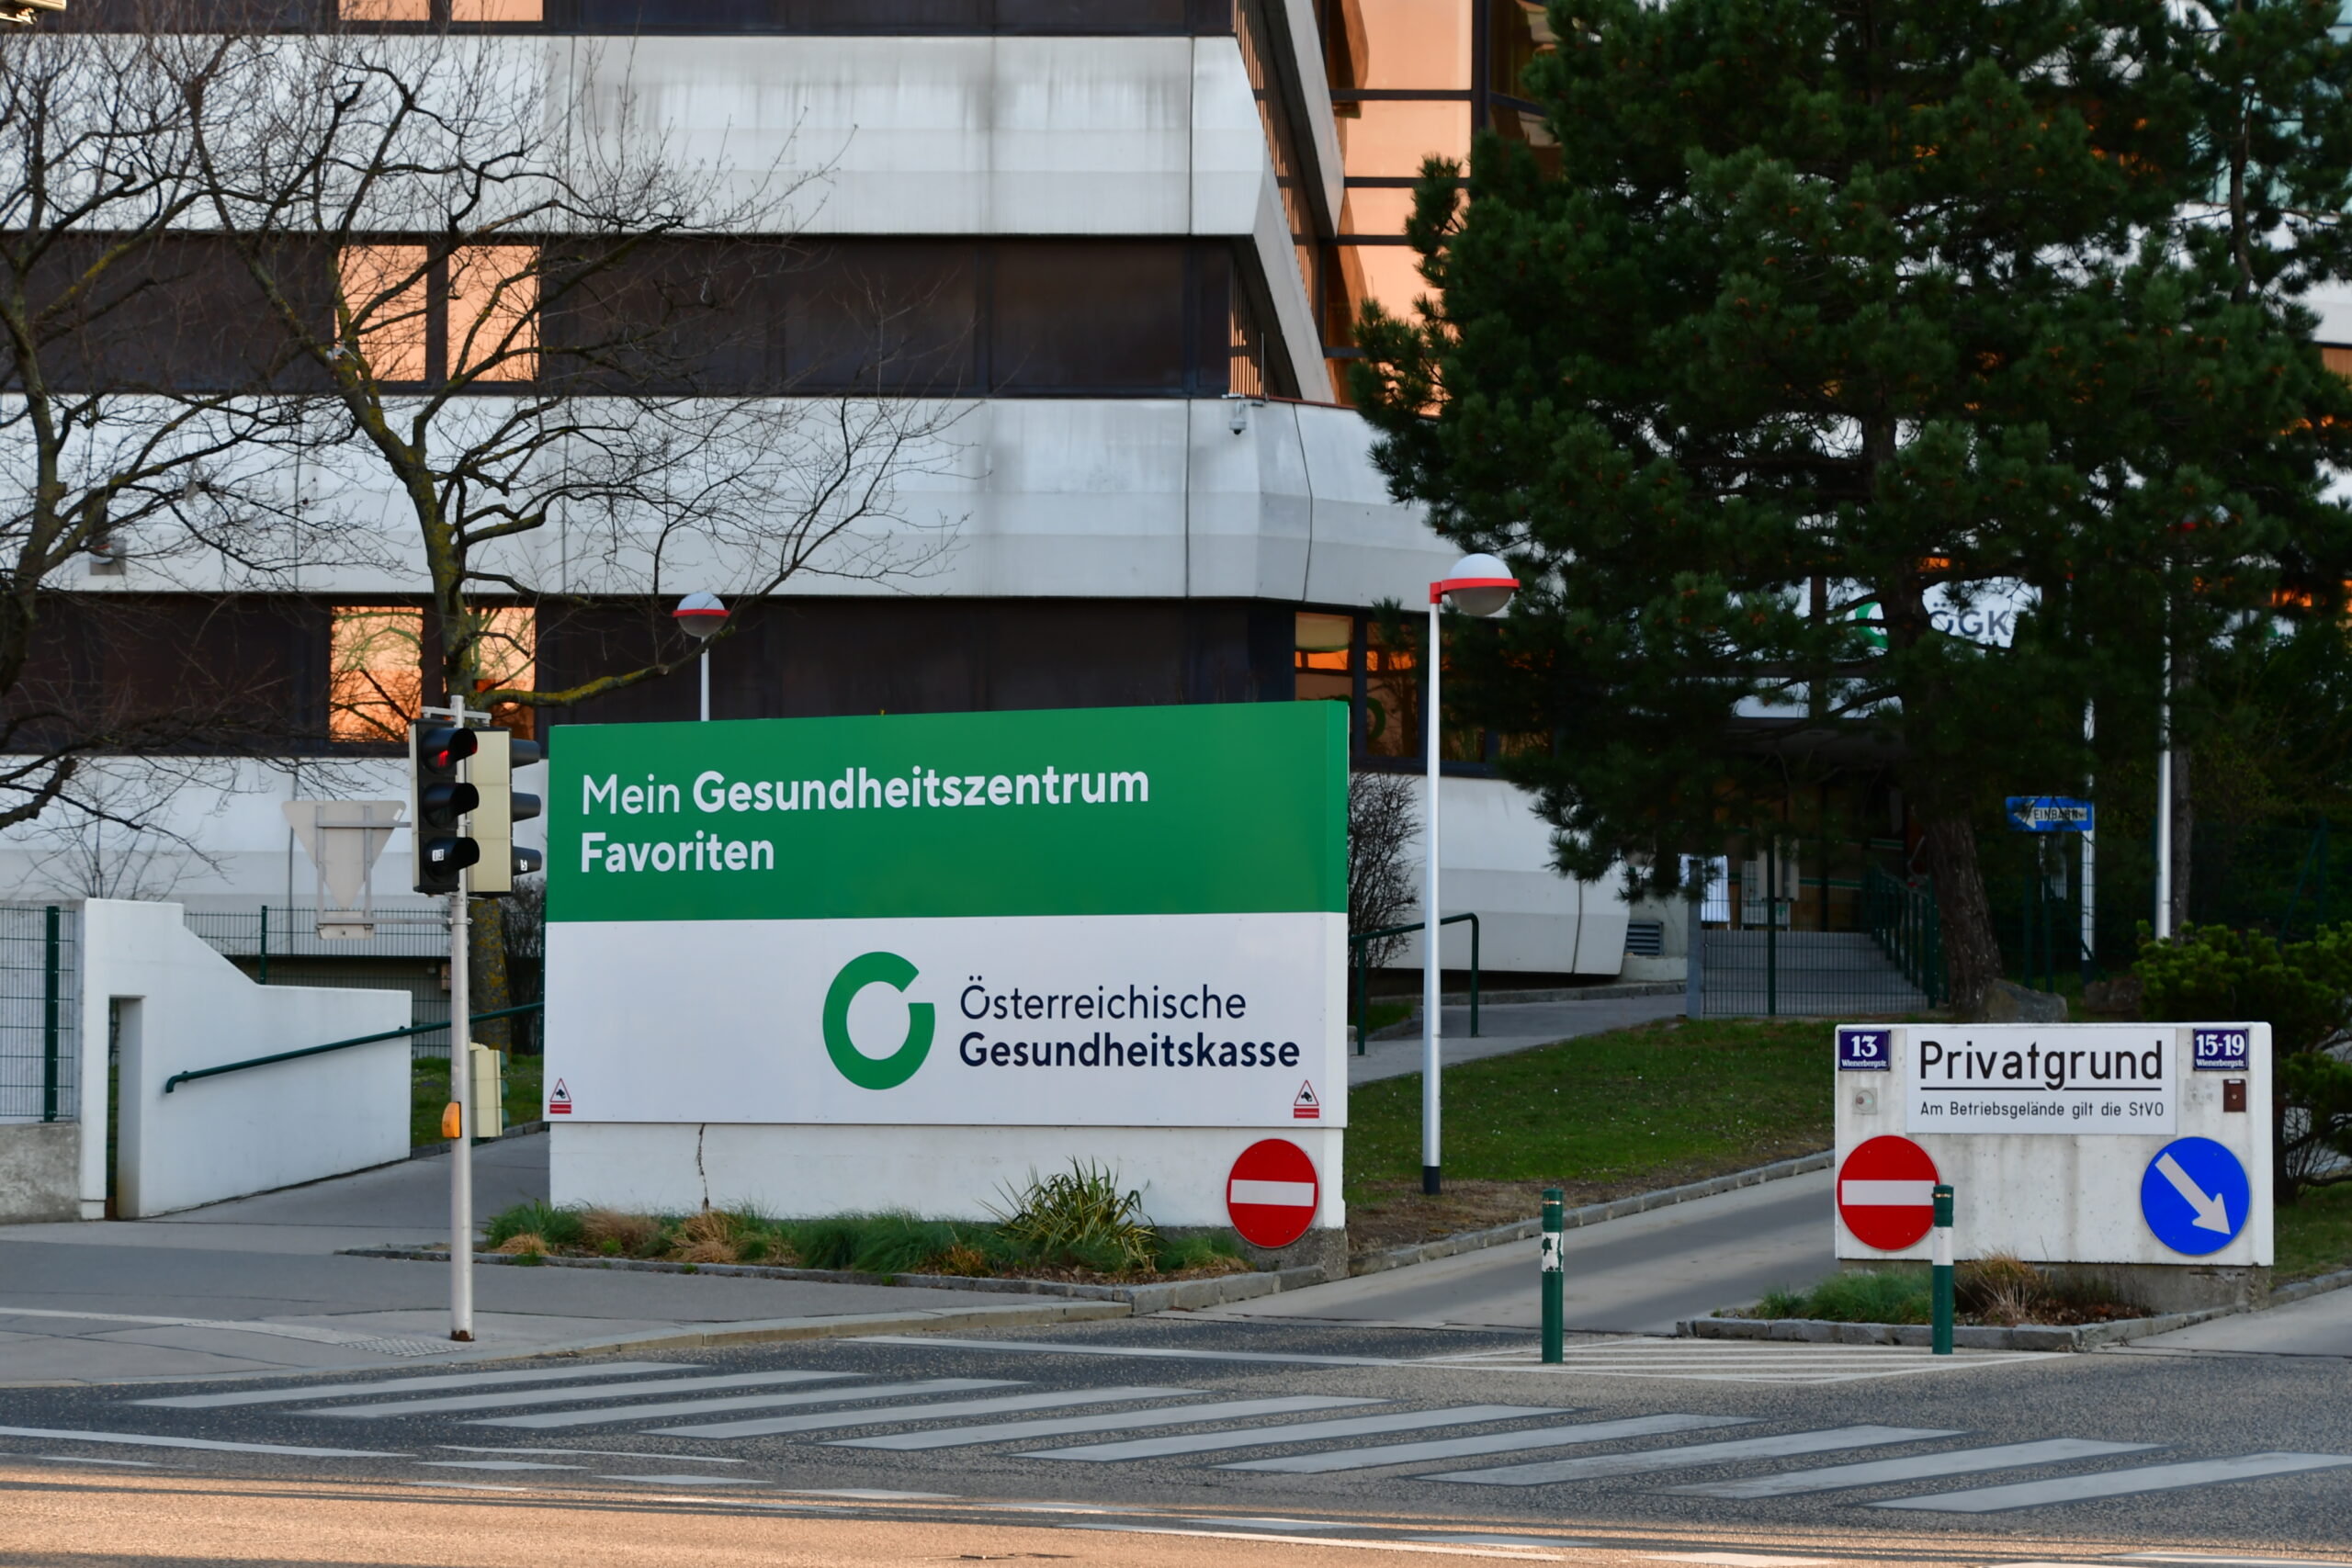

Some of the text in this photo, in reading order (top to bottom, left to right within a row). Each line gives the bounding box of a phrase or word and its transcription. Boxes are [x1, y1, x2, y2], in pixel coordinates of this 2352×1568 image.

[582, 765, 1148, 815] Mein Gesundheitszentrum
[581, 829, 775, 873] Favoriten
[960, 976, 1246, 1020] Österreichische
[960, 1032, 1300, 1067] Gesundheitskasse
[1851, 1035, 1878, 1057] 13
[2196, 1034, 2245, 1056] 15-19
[1920, 1040, 2162, 1090] Privatgrund
[2196, 1058, 2245, 1068] Wienerbergstr.
[1920, 1101, 2164, 1120] Am Betriebsgelände gilt die StVO
